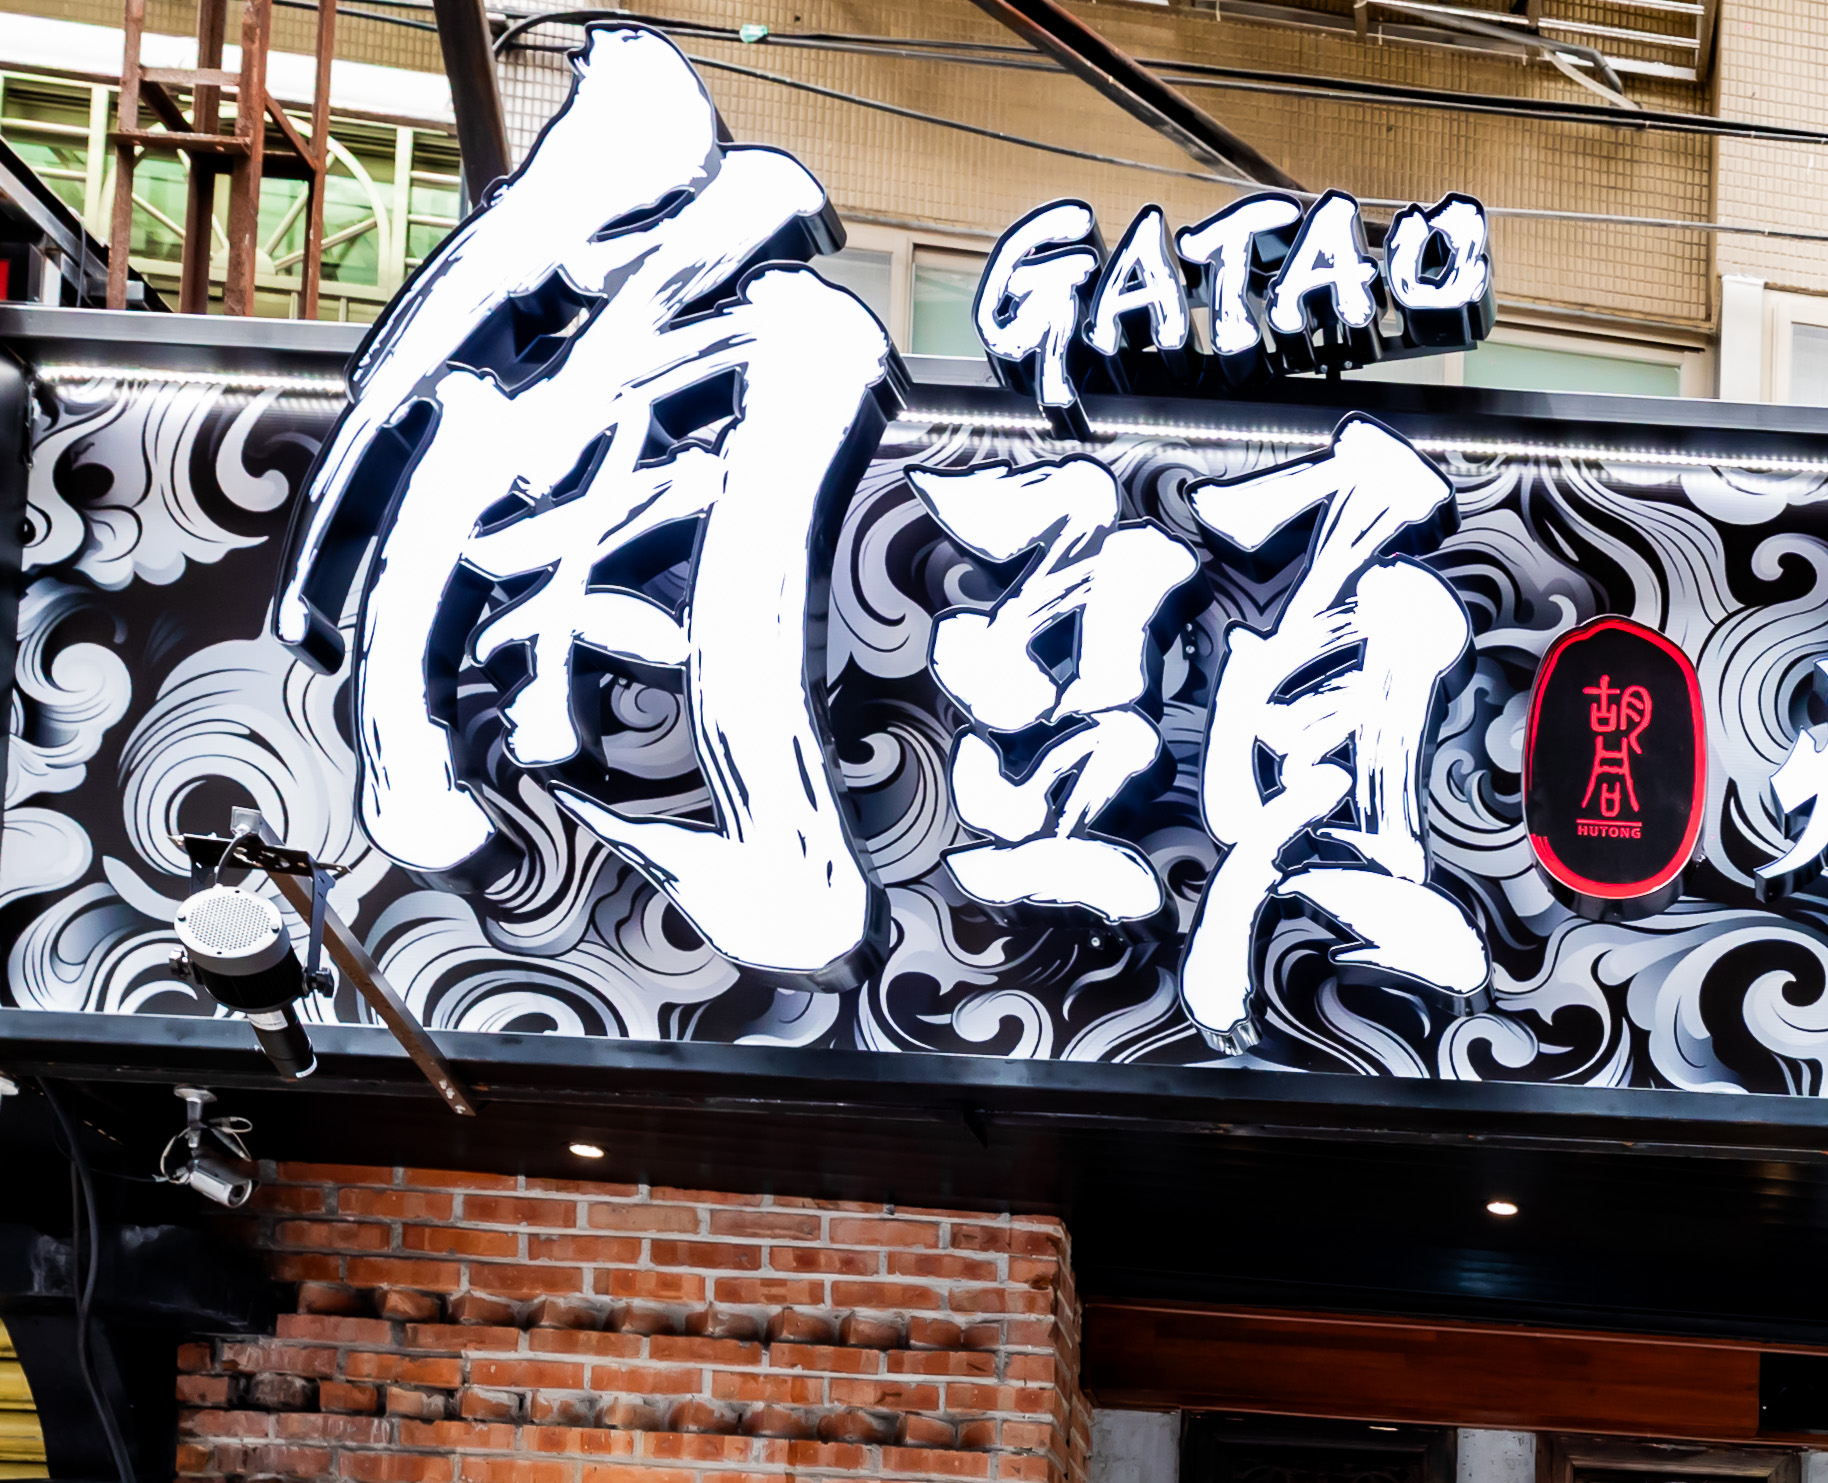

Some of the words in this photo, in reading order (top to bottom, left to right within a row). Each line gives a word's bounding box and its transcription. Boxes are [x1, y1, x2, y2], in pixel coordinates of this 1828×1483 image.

[974, 192, 1494, 420] GATAO
[274, 20, 1496, 1056] 角頭
[1576, 824, 1643, 839] HUTONG
